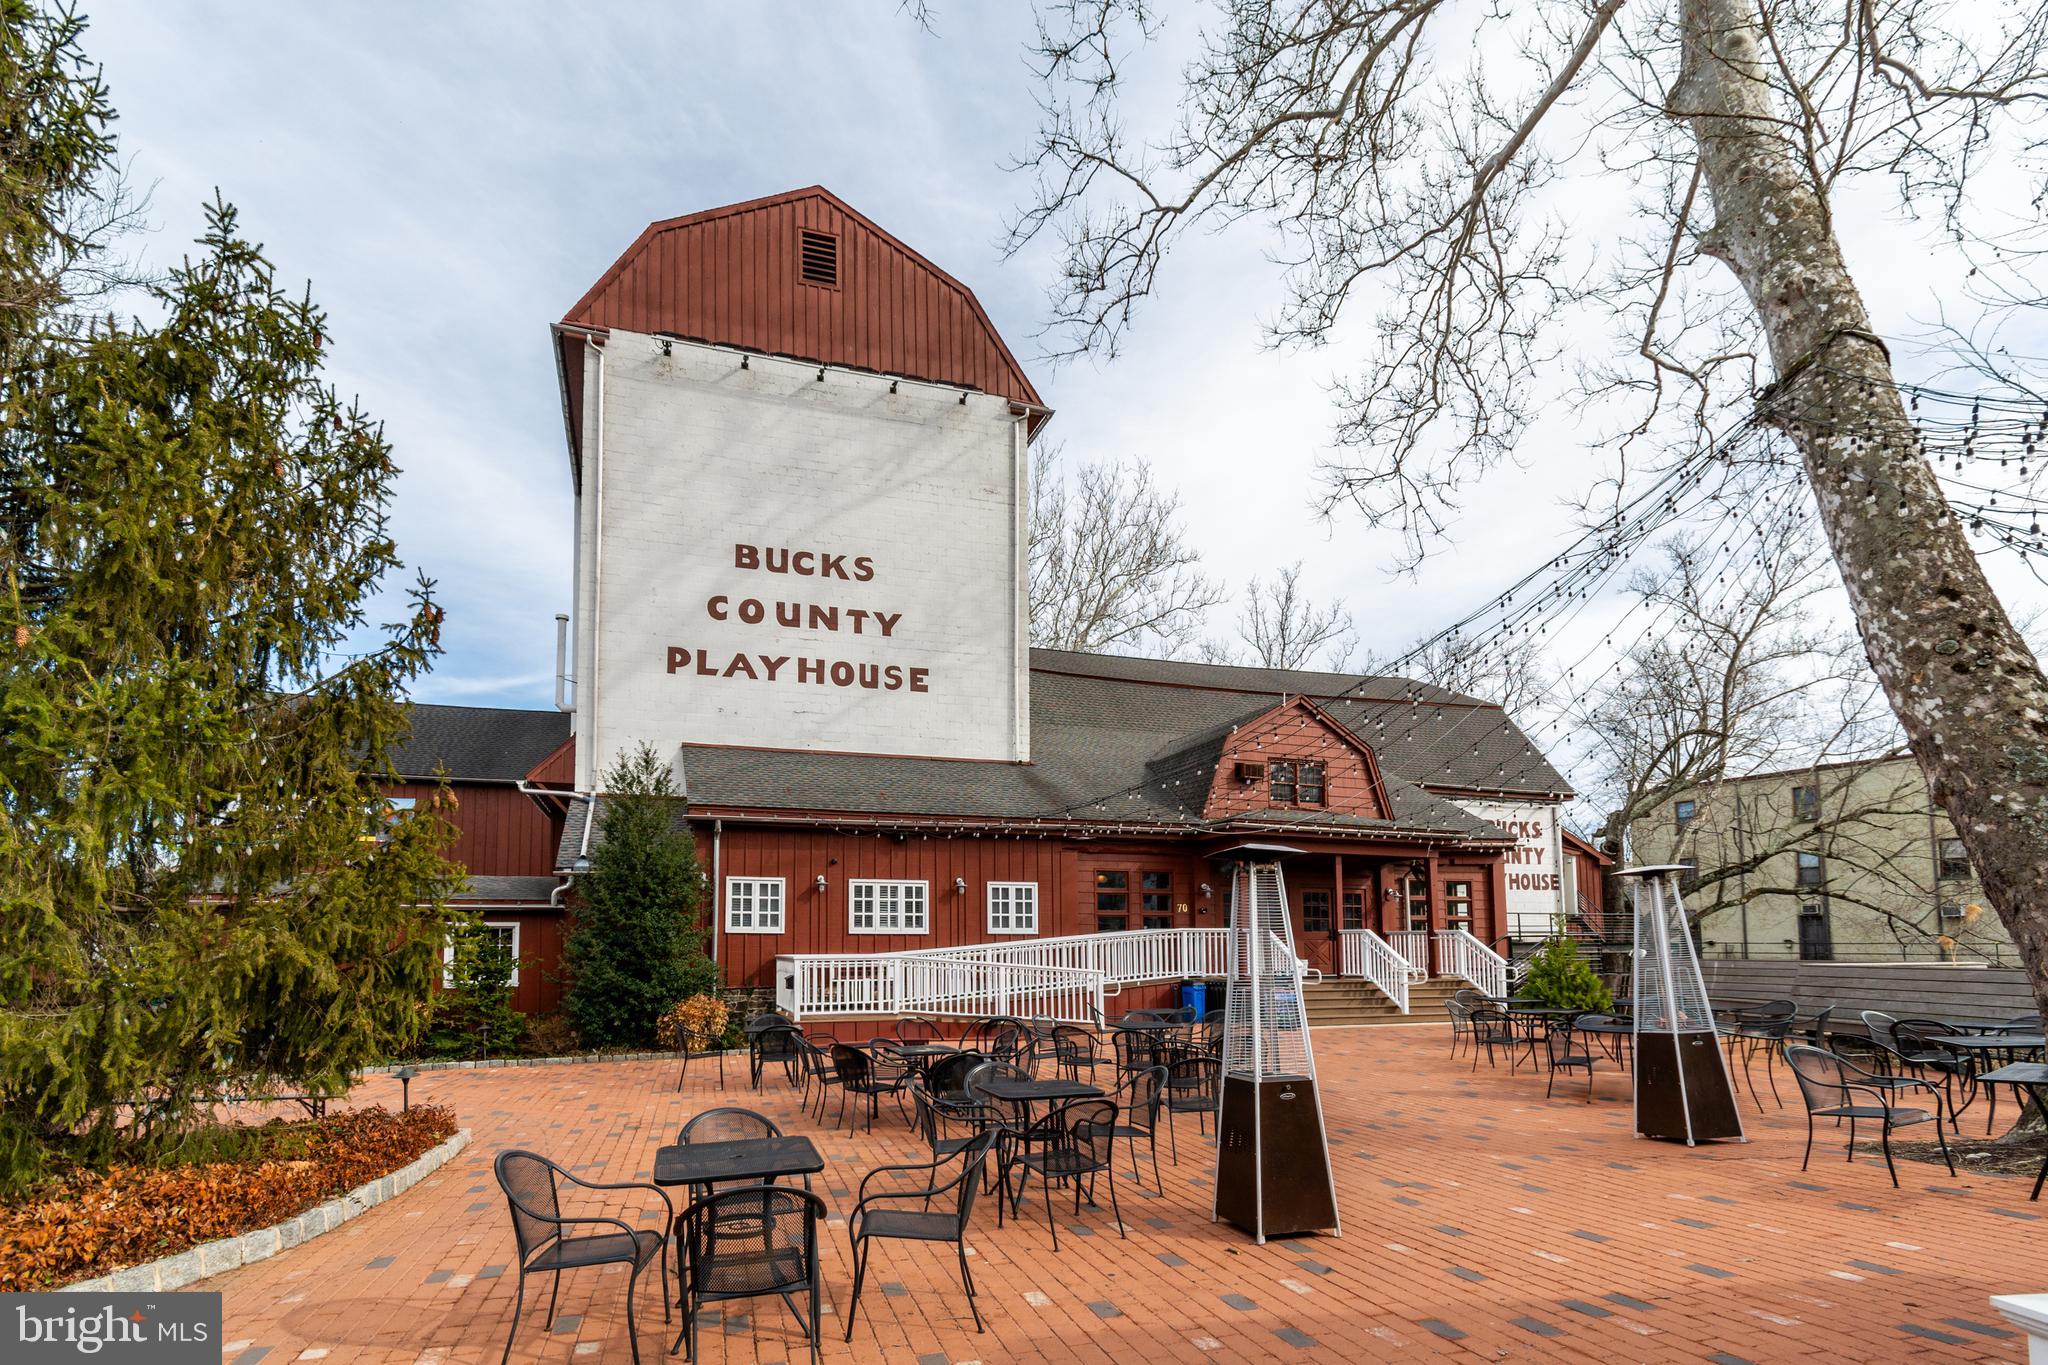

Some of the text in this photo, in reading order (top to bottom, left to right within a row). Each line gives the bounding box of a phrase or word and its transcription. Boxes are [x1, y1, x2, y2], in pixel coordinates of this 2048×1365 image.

[734, 543, 875, 582] BUCKS
[706, 595, 903, 637] COUNTY
[666, 646, 930, 693] PLAYHOUSE
[1488, 820, 1542, 839] CKS
[1503, 847, 1546, 865] UNTY
[1505, 873, 1560, 891] HOUSE
[1176, 903, 1188, 913] 70
